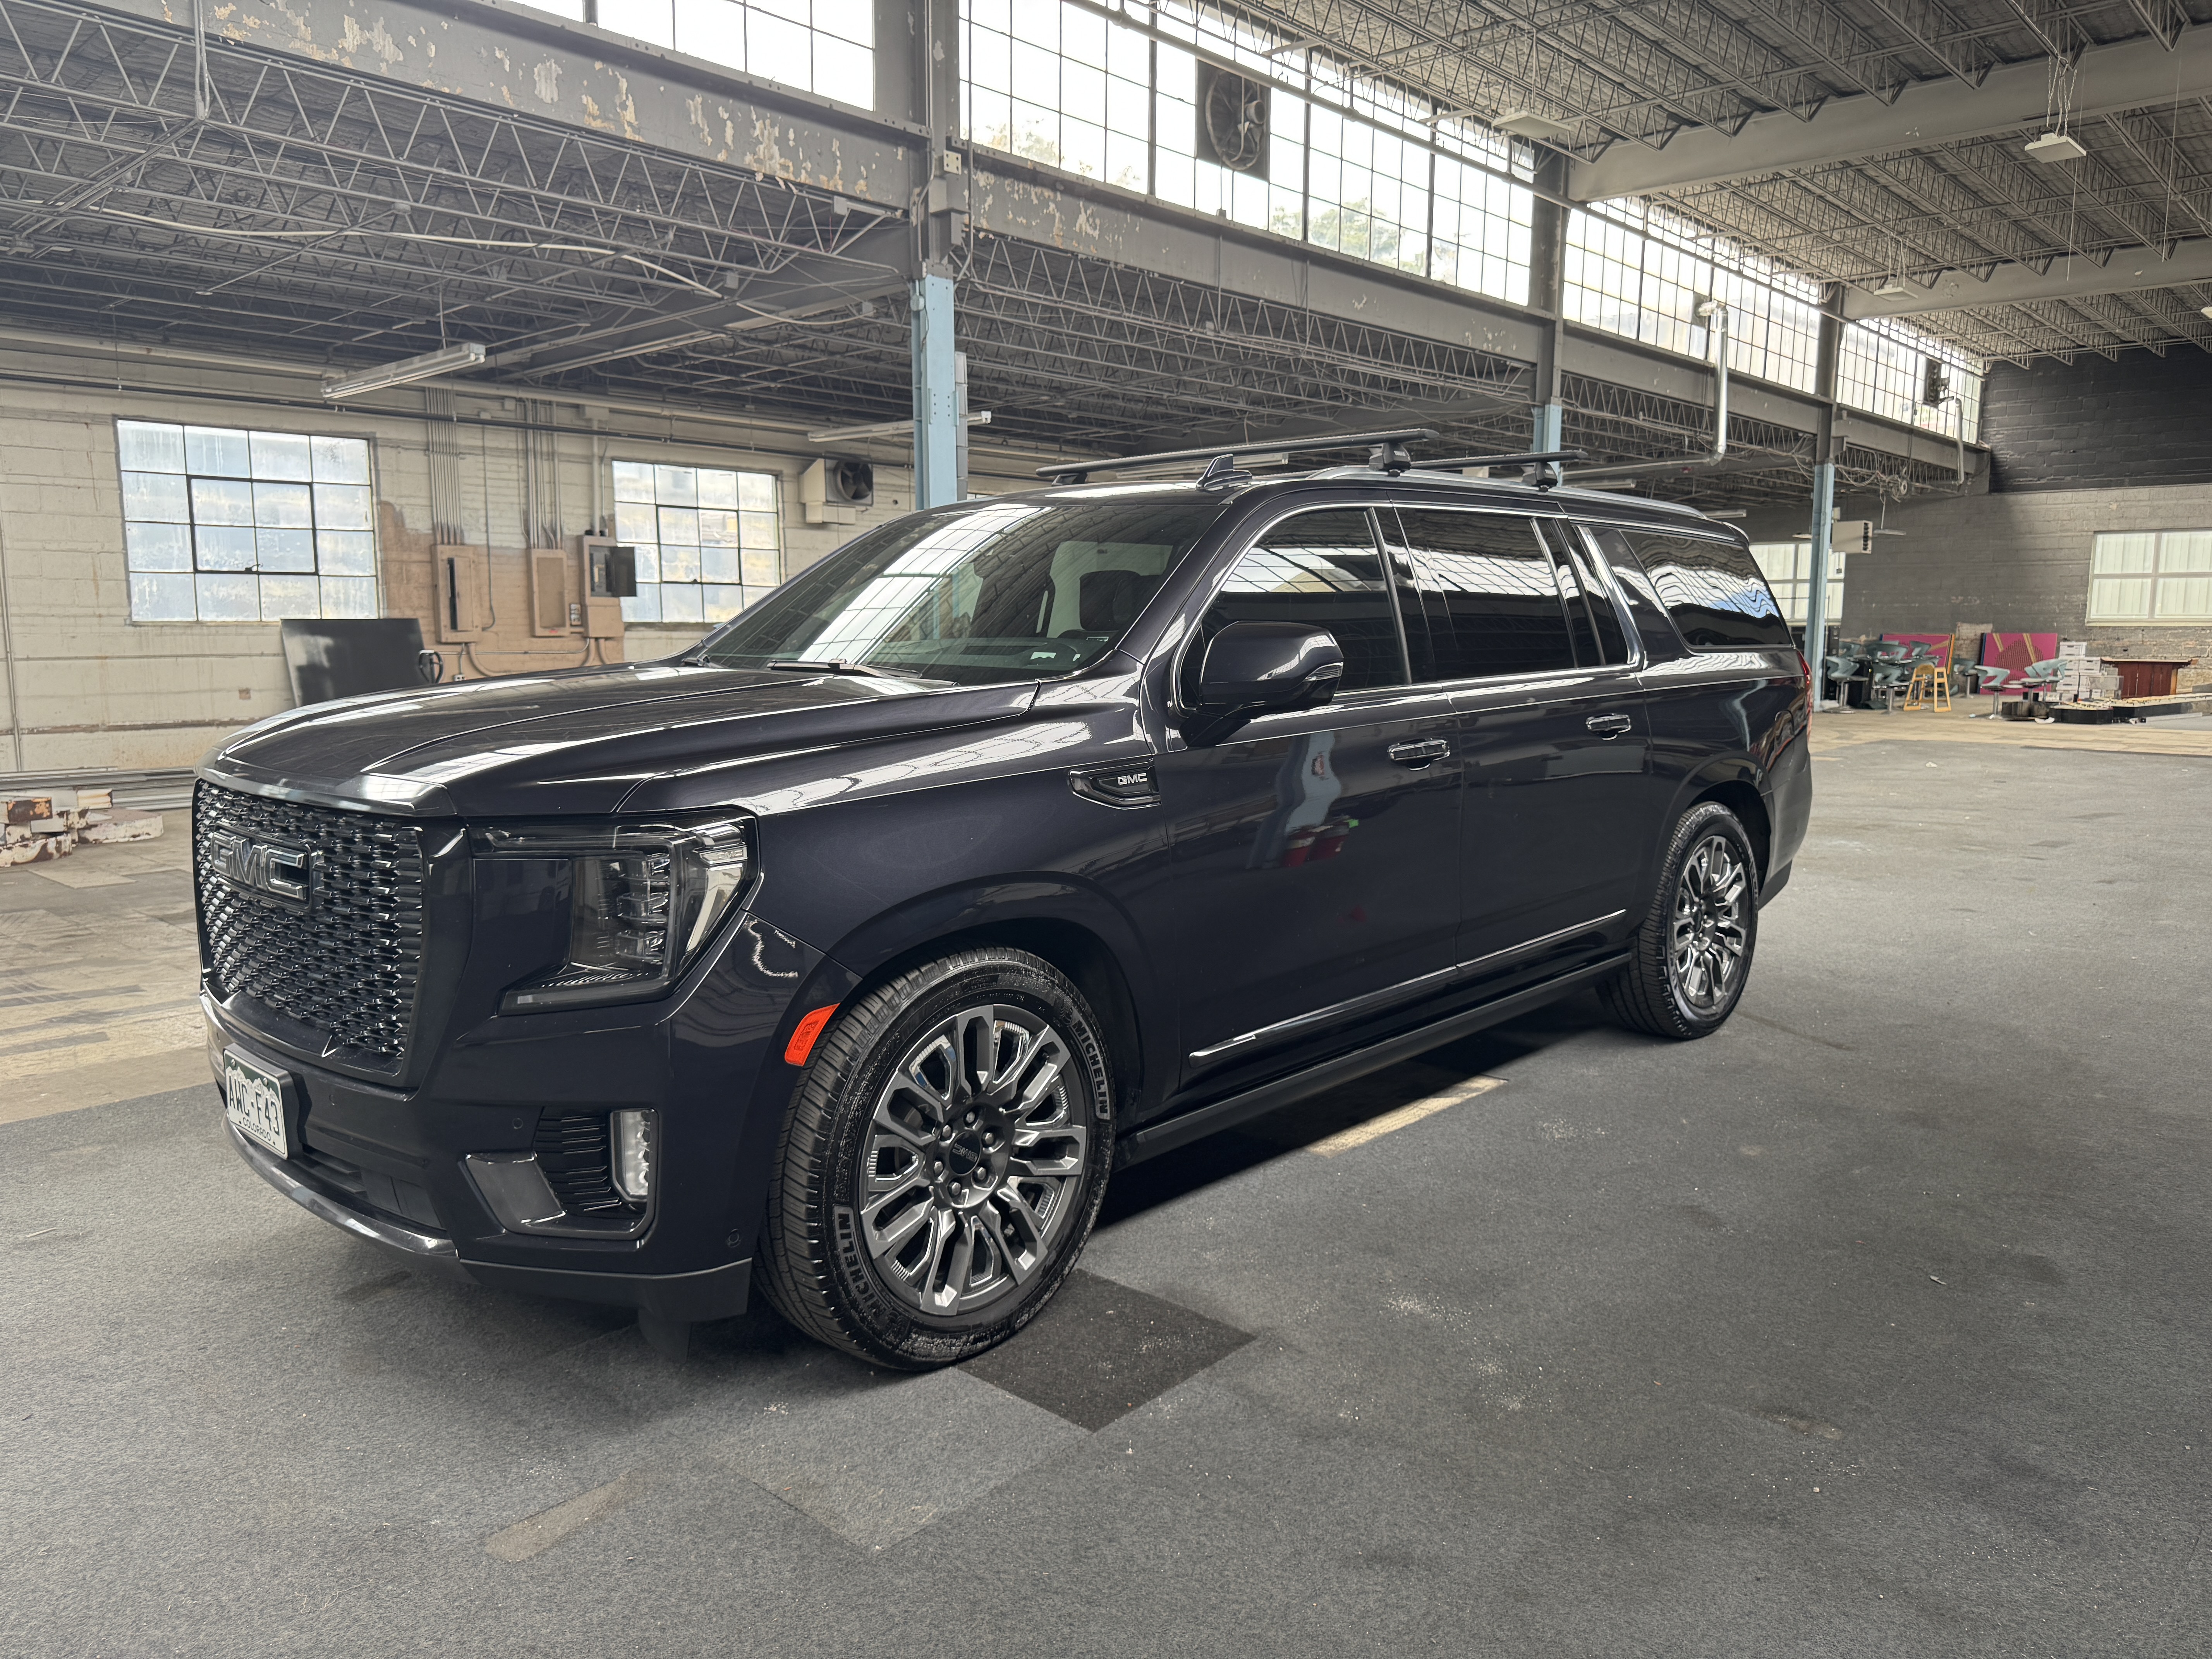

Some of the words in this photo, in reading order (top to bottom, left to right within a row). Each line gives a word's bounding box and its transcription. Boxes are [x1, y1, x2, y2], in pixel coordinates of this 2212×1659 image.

[1118, 773, 1147, 785] GMC
[211, 831, 307, 900] GMC
[1072, 1020, 1108, 1114] MICHELIN
[242, 1117, 271, 1142] COLORADO
[952, 1142, 978, 1162] GMC
[838, 1213, 887, 1316] MICHELIN
